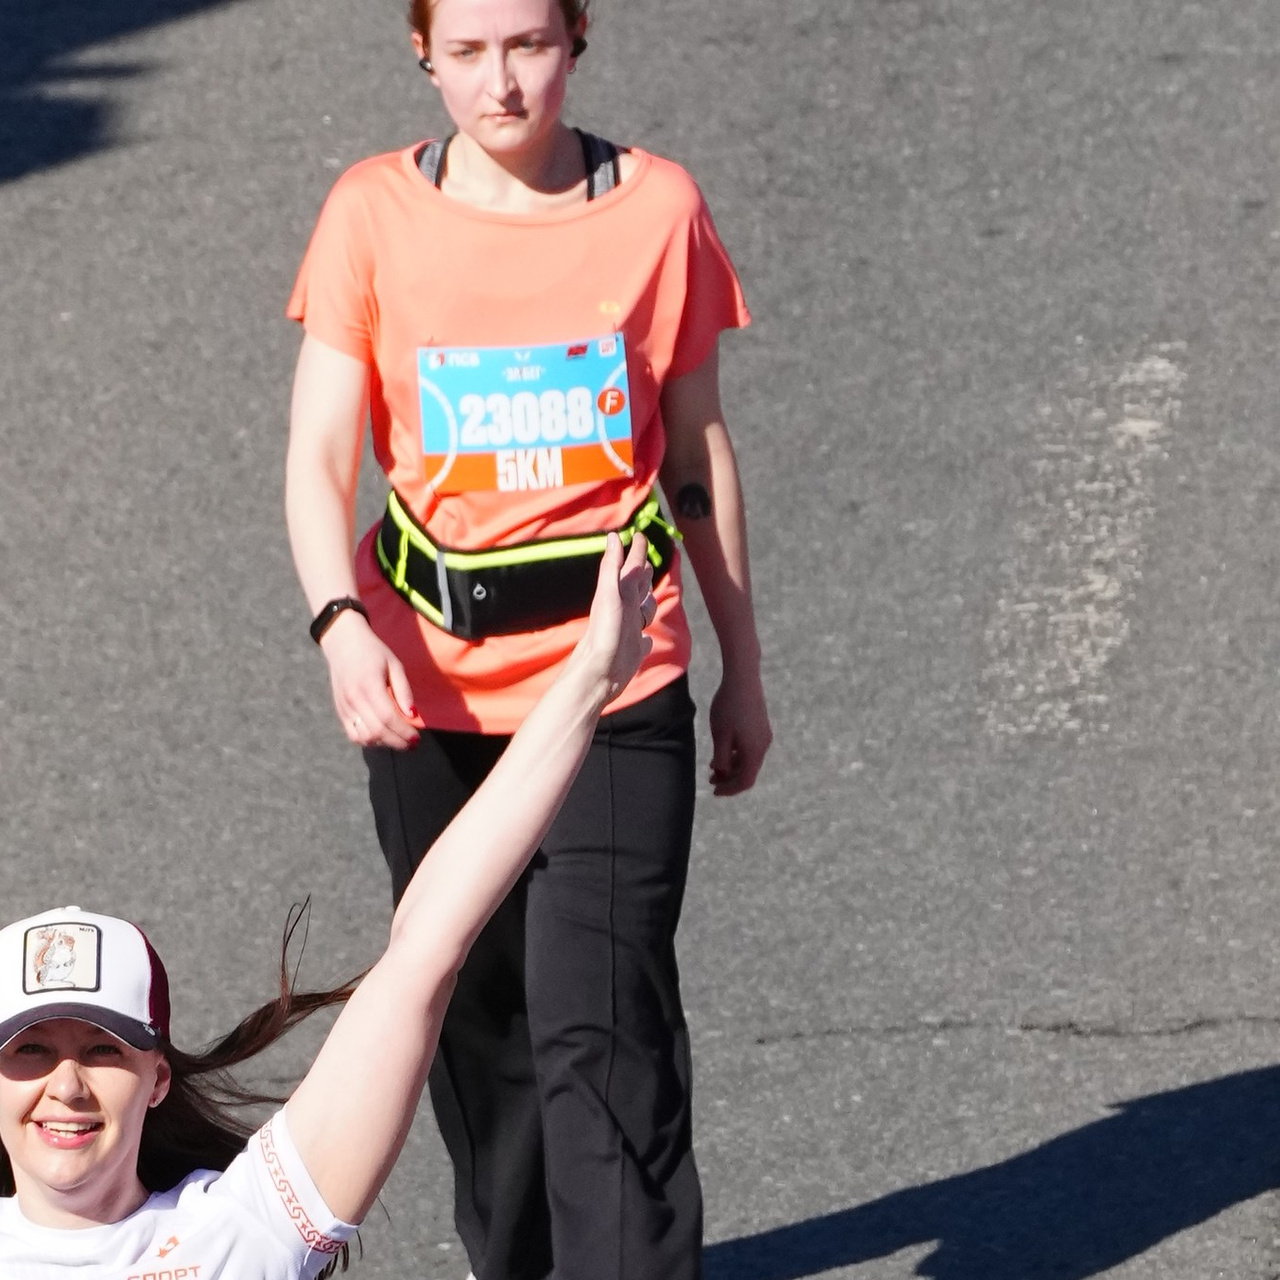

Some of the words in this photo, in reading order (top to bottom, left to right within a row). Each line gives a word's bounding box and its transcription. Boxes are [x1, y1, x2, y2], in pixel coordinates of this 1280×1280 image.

[460, 386, 595, 446] 23088
[606, 390, 619, 414] F
[497, 448, 564, 493] 5KM
